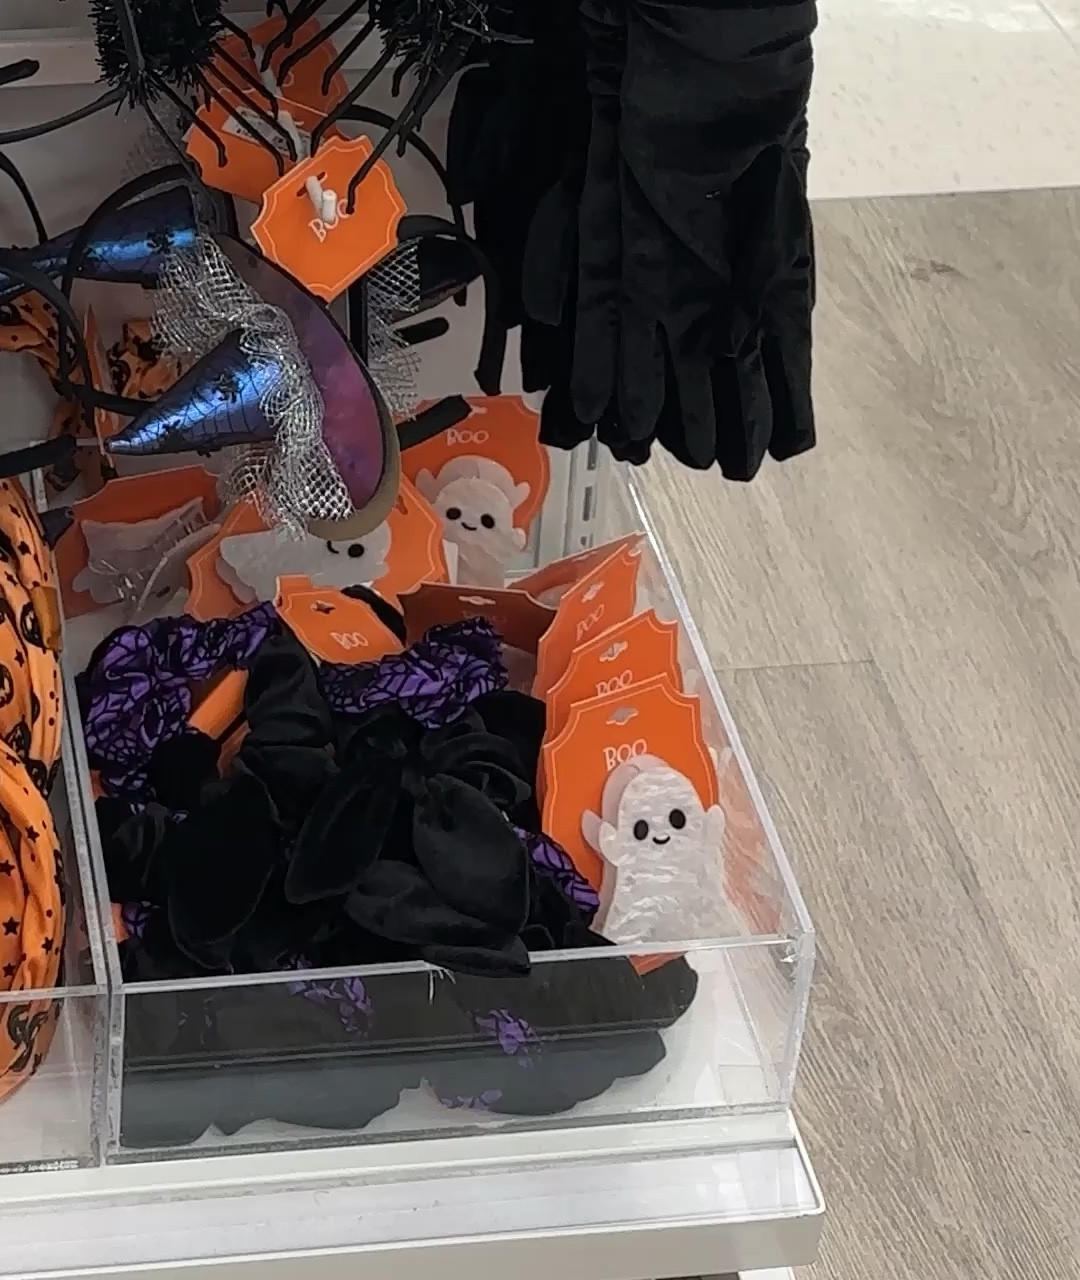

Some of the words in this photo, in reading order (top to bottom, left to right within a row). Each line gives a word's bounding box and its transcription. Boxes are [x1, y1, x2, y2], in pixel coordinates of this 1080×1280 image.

[575, 603, 605, 641] BOO
[330, 632, 369, 651] BOO
[595, 669, 634, 696] BOO
